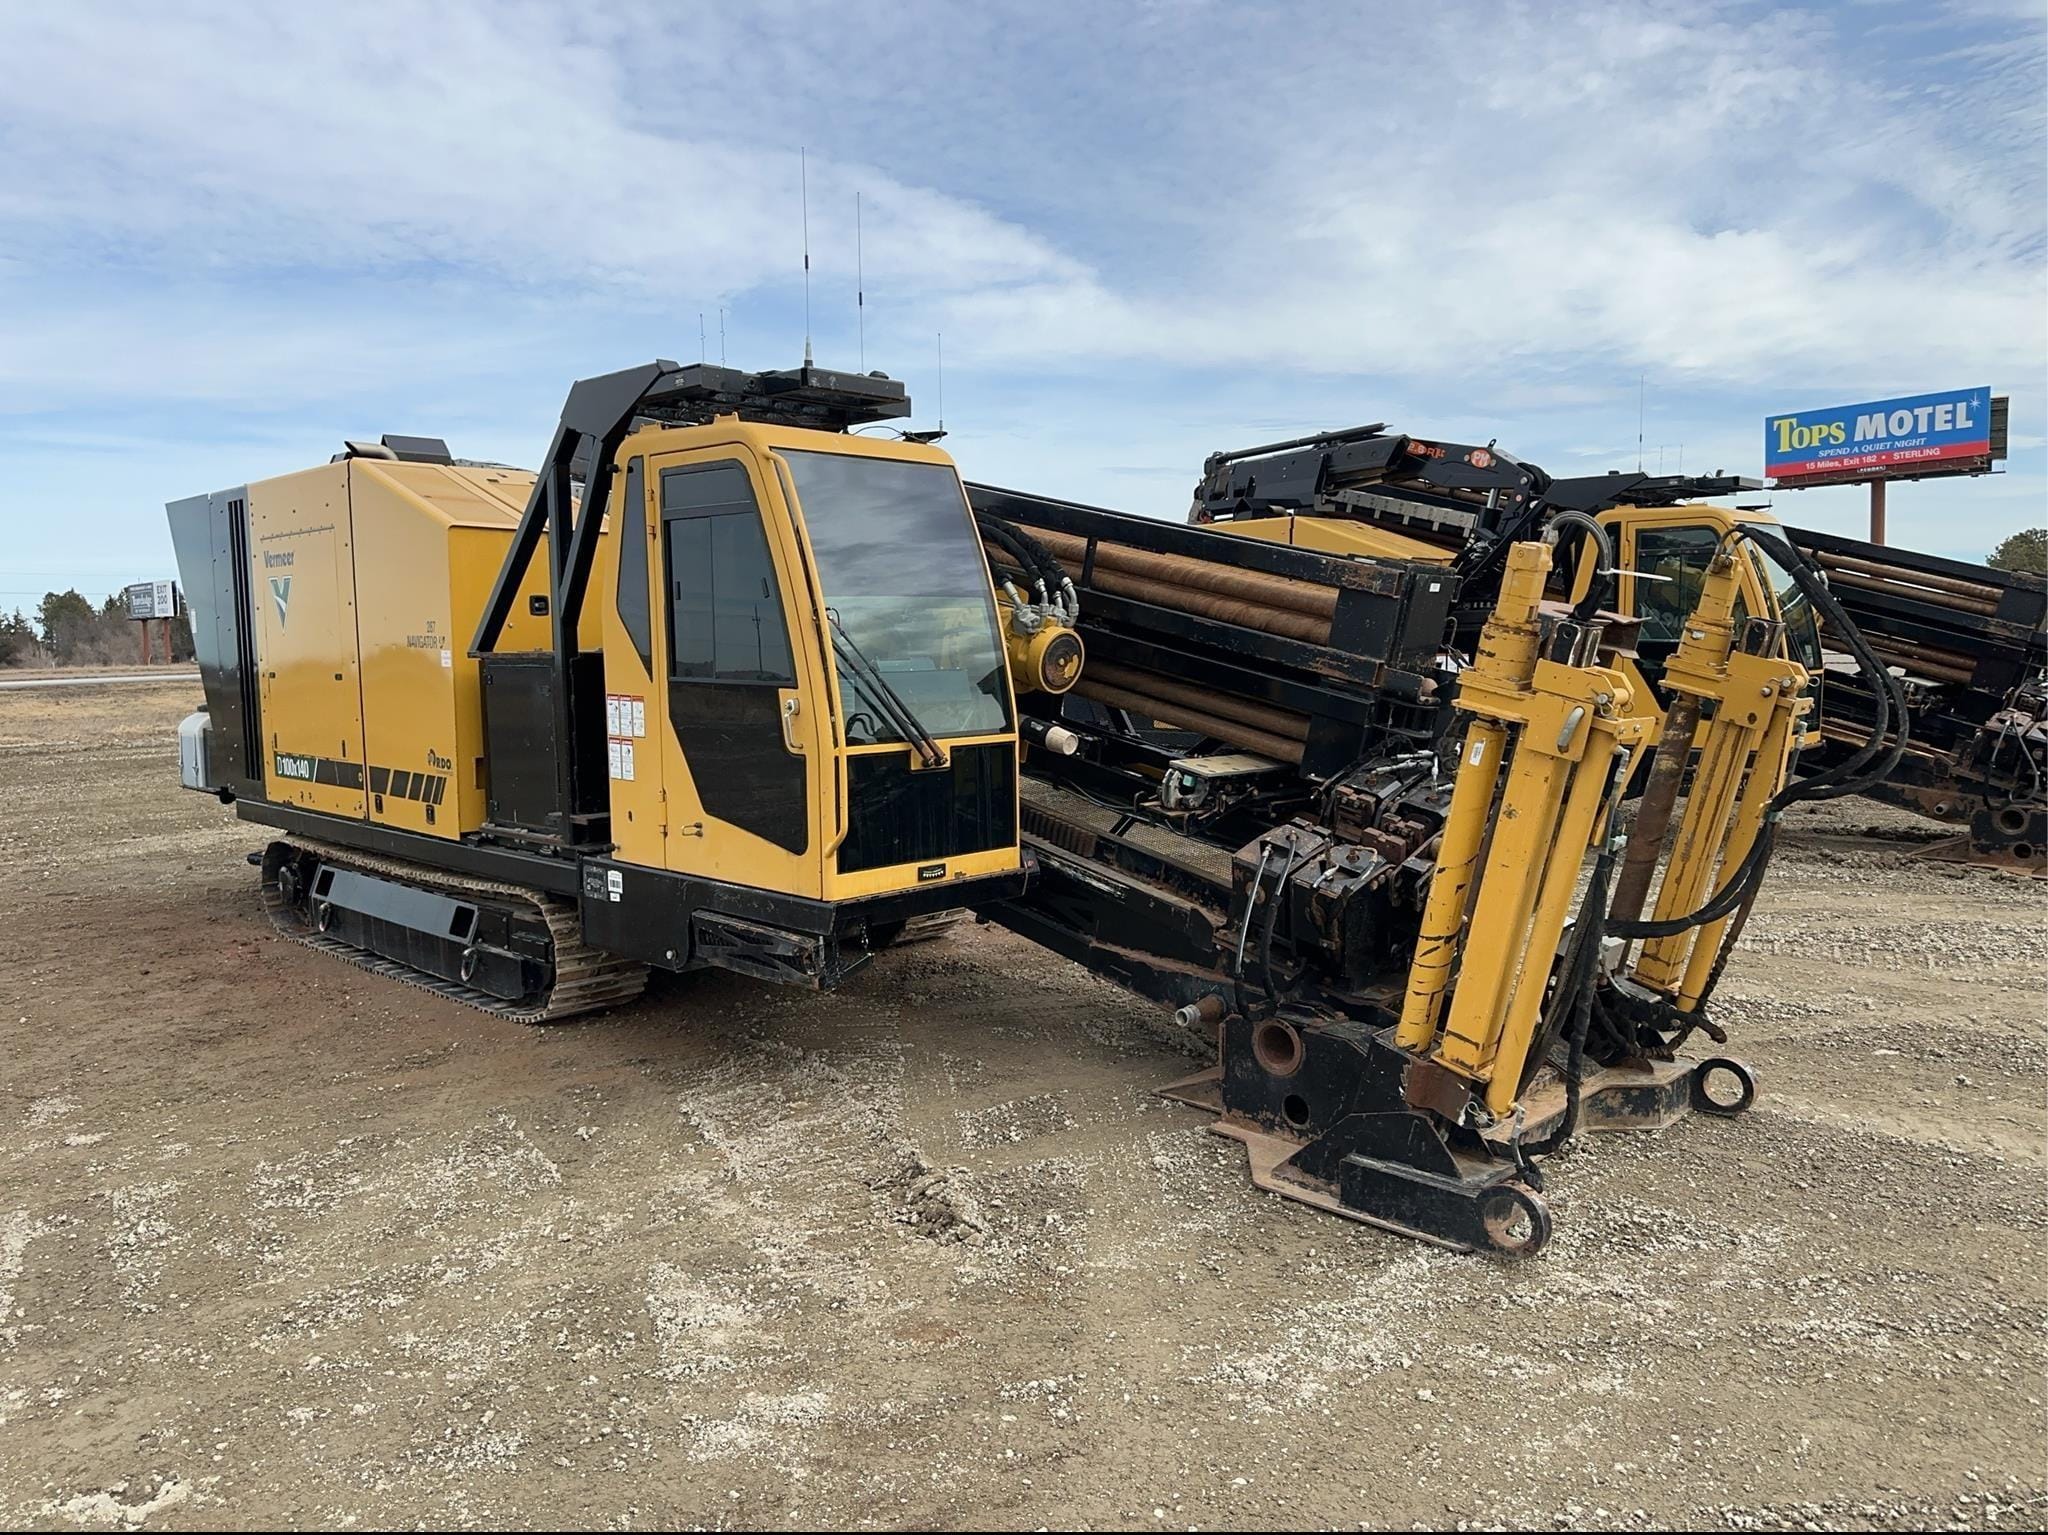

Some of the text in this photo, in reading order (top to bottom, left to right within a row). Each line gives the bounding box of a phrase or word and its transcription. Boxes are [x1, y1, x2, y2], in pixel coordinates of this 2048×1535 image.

[1853, 402, 1973, 442] MOTEL
[1818, 448, 1850, 458] SPEND
[1861, 441, 1893, 453] QUIET
[1894, 438, 1927, 449] NIGHT
[1806, 447, 1941, 470] 15 Miles, Exit 182 STERLING
[264, 550, 295, 569] Vermeer
[156, 584, 168, 594] EXIT
[406, 635, 438, 649] NAVIGATOR
